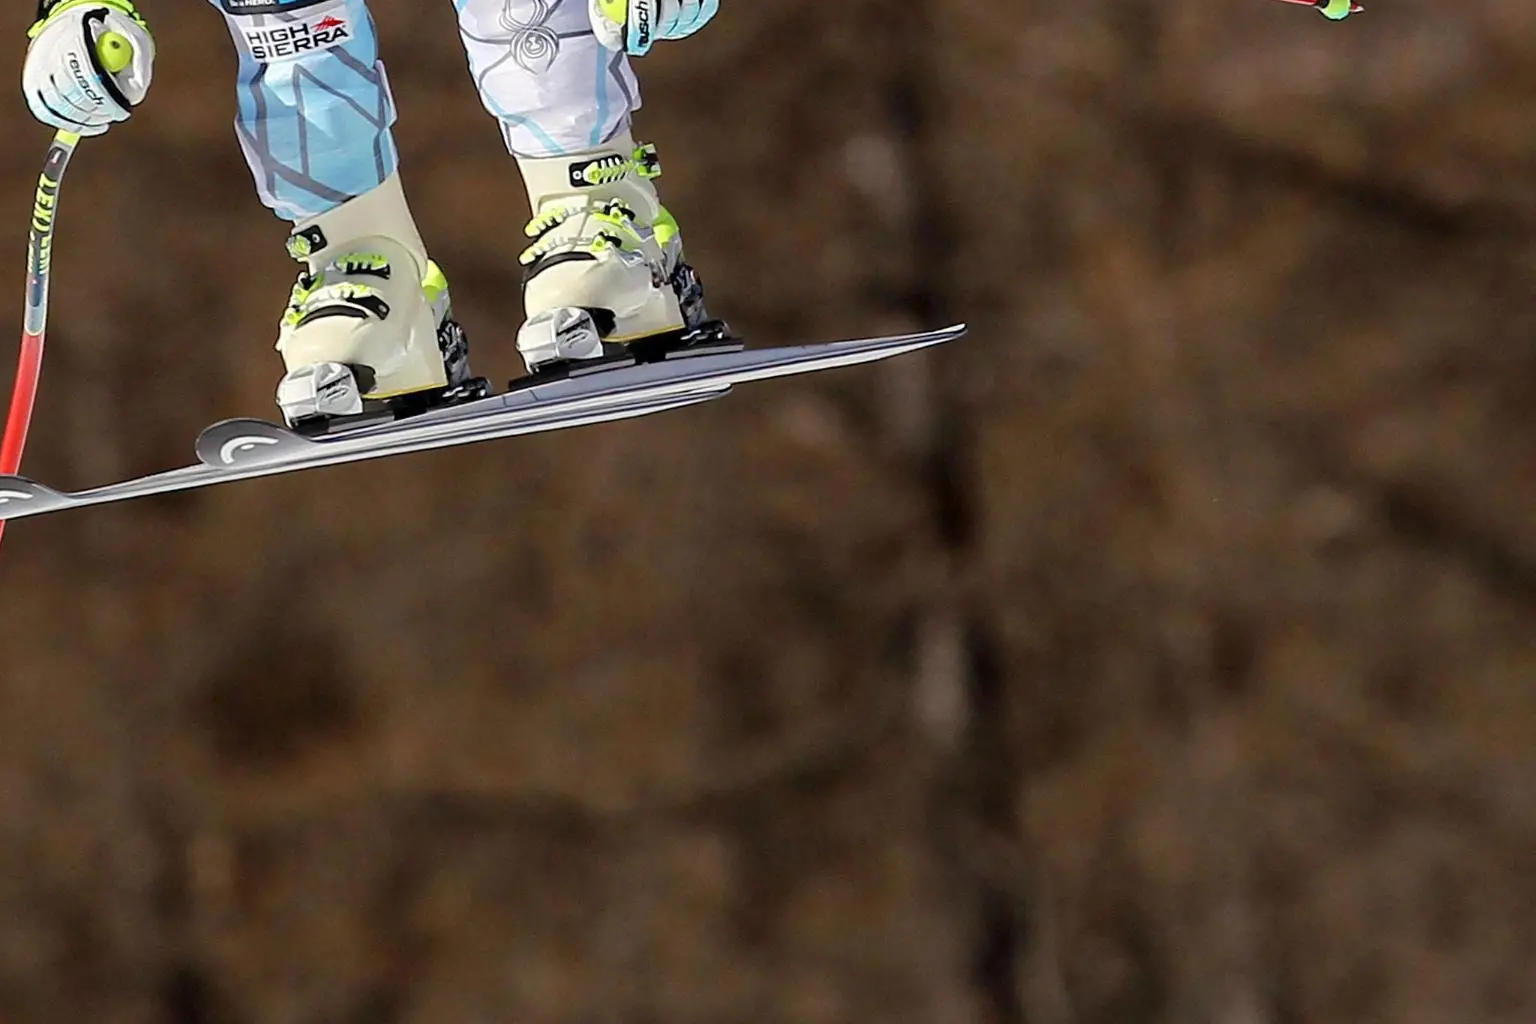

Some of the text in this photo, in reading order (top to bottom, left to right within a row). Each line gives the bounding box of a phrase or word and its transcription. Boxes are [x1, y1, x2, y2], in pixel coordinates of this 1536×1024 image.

[247, 23, 308, 45] HIGH
[252, 27, 349, 60] SIERRA
[67, 51, 104, 106] reusch
[31, 172, 58, 233] LEKI
